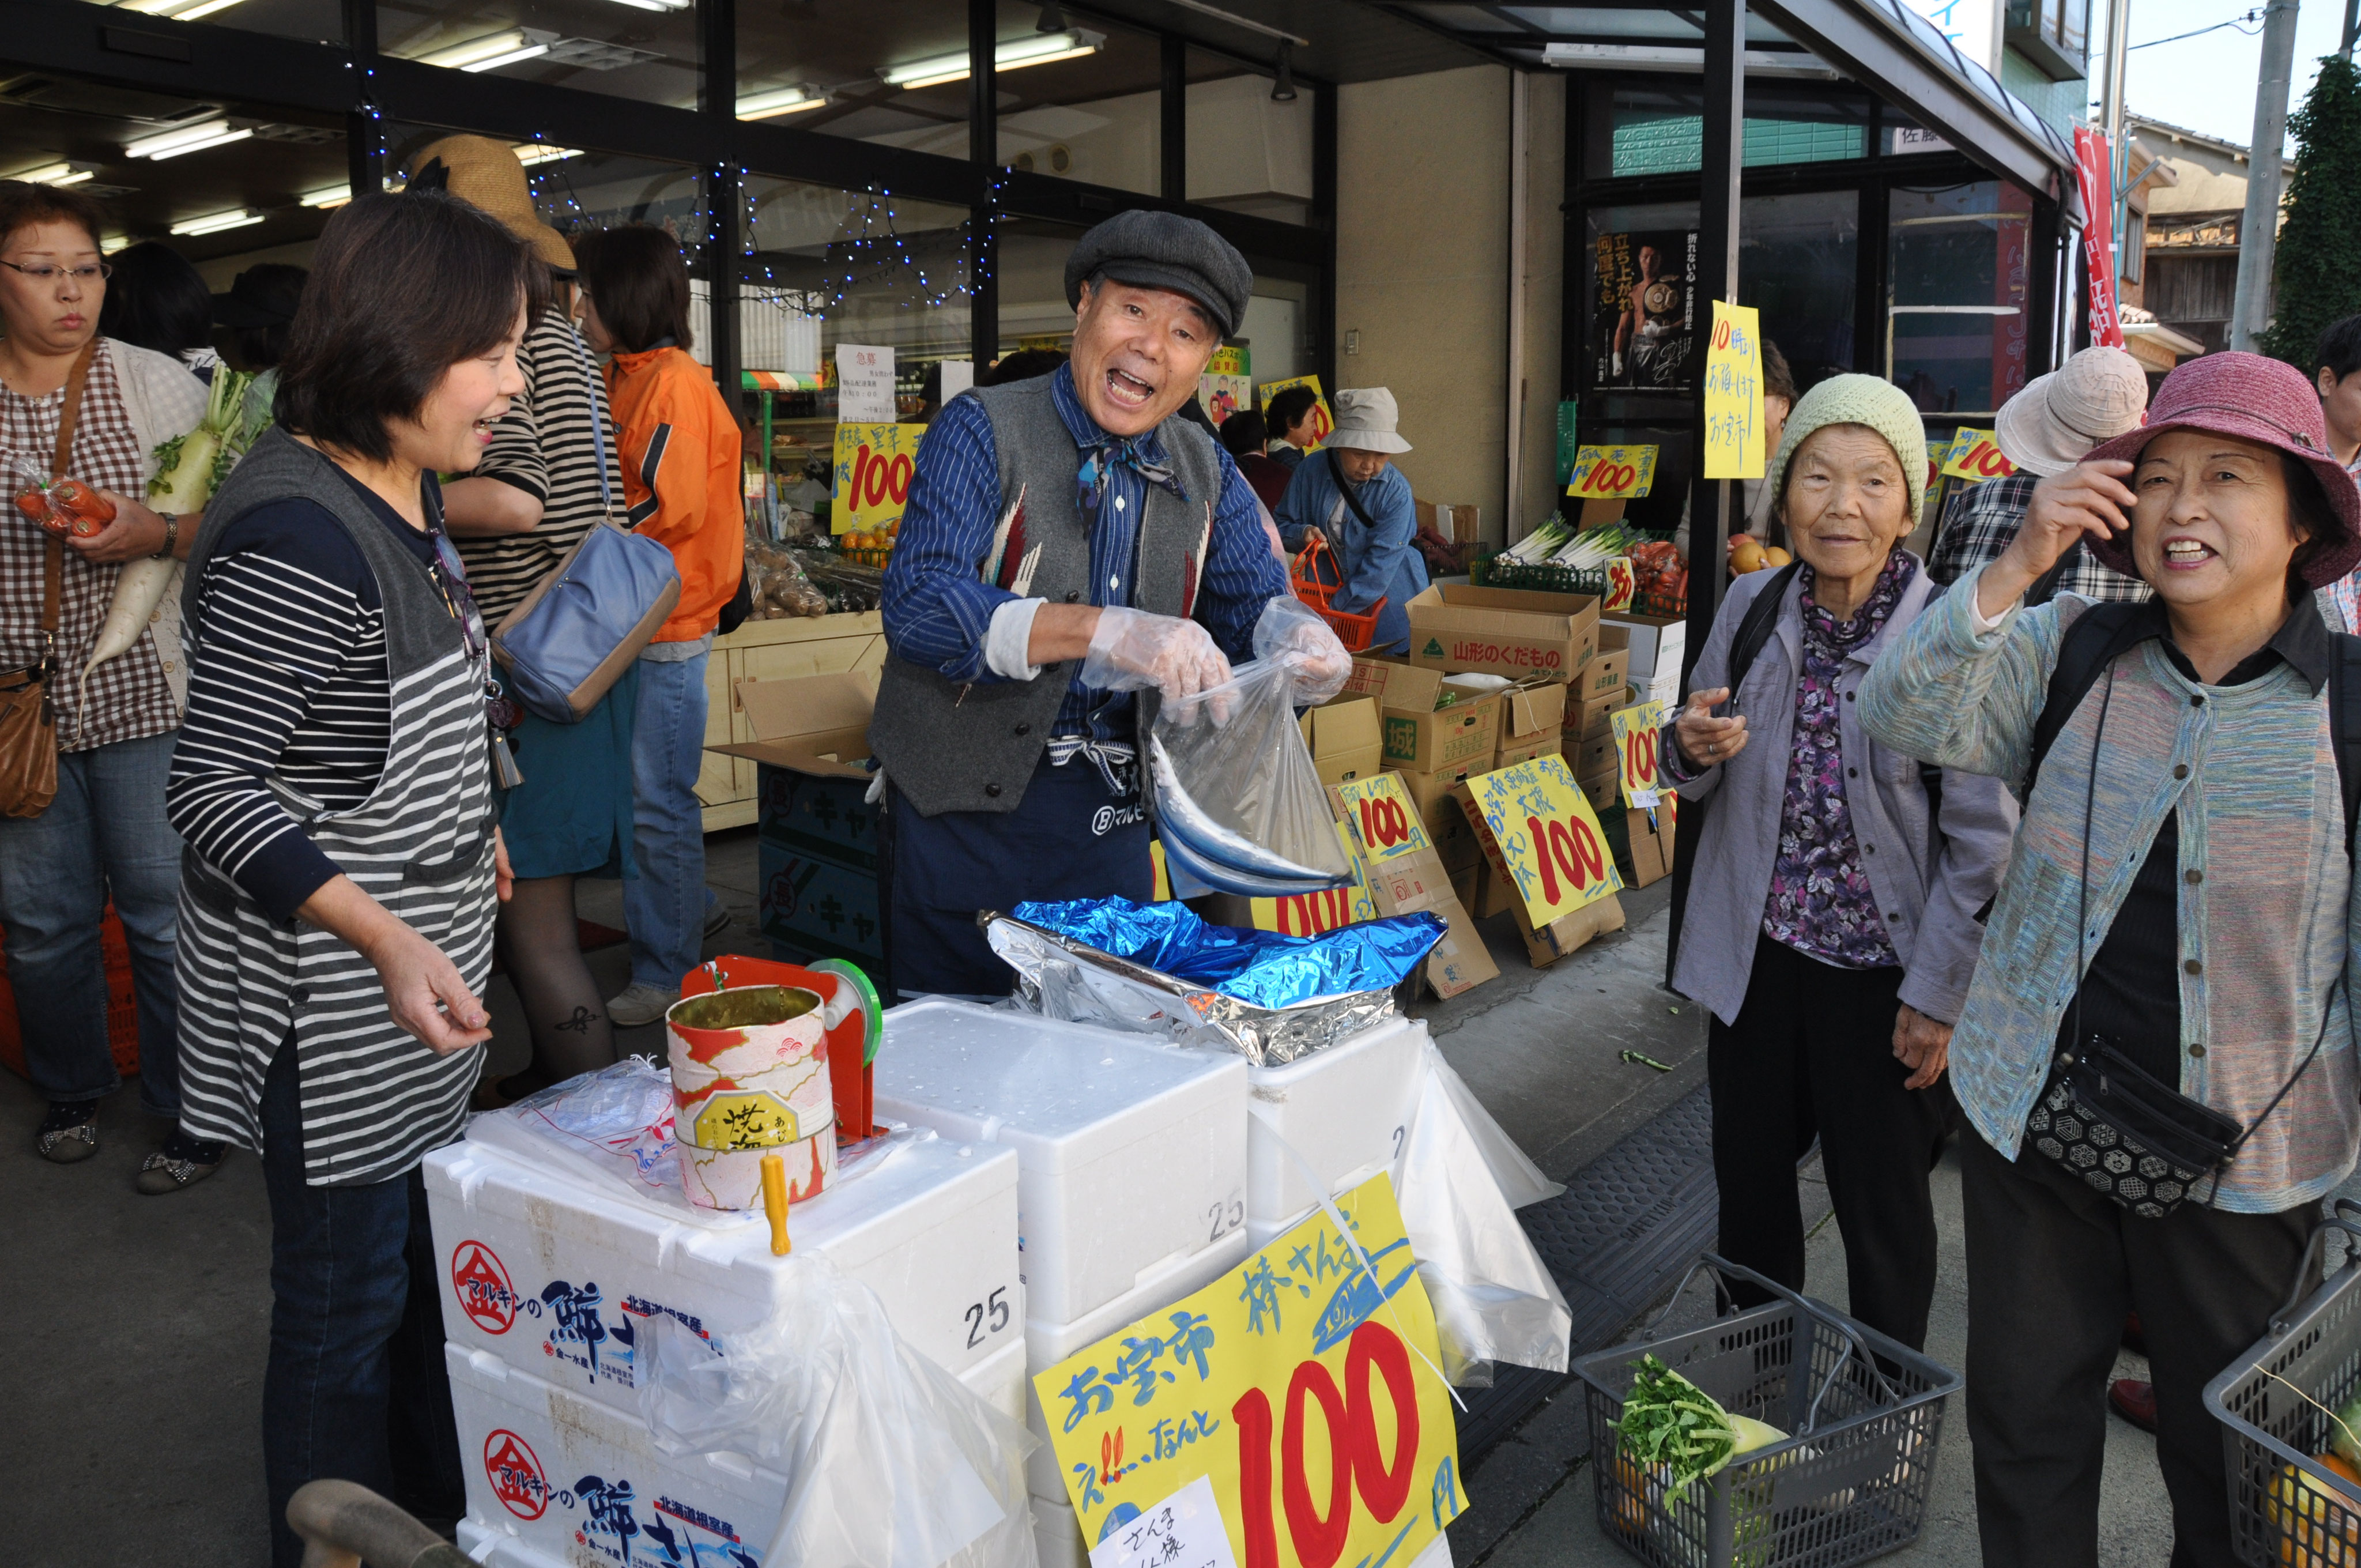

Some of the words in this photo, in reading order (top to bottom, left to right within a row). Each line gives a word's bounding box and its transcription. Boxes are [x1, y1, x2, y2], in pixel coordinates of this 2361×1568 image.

[1597, 235, 1615, 304] 何度でも
[1615, 233, 1634, 313] 立ち上がれ
[856, 352, 877, 366] 急募
[849, 444, 912, 512] 100
[1582, 458, 1636, 492] 100
[1359, 668, 1366, 677] S
[1454, 640, 1561, 669] 山形のくだもの
[1595, 673, 1619, 690] 山形県産
[1389, 722, 1415, 756] 城
[1359, 796, 1409, 849] 100
[1409, 826, 1427, 849] 円
[1527, 815, 1604, 906] 100
[1209, 1186, 1244, 1242] 25
[466, 1278, 541, 1318] マルキンの
[965, 1285, 1009, 1350] 25
[556, 1347, 589, 1369] 金一水産
[1058, 1310, 1215, 1434] お宝市
[1231, 1320, 1419, 1568] 100
[1431, 1454, 1458, 1532] 円
[500, 1465, 575, 1509] マルキンの
[659, 1495, 735, 1540] 北海道根室産
[1123, 1507, 1175, 1551] さんま
[588, 1538, 621, 1561] 金一水産
